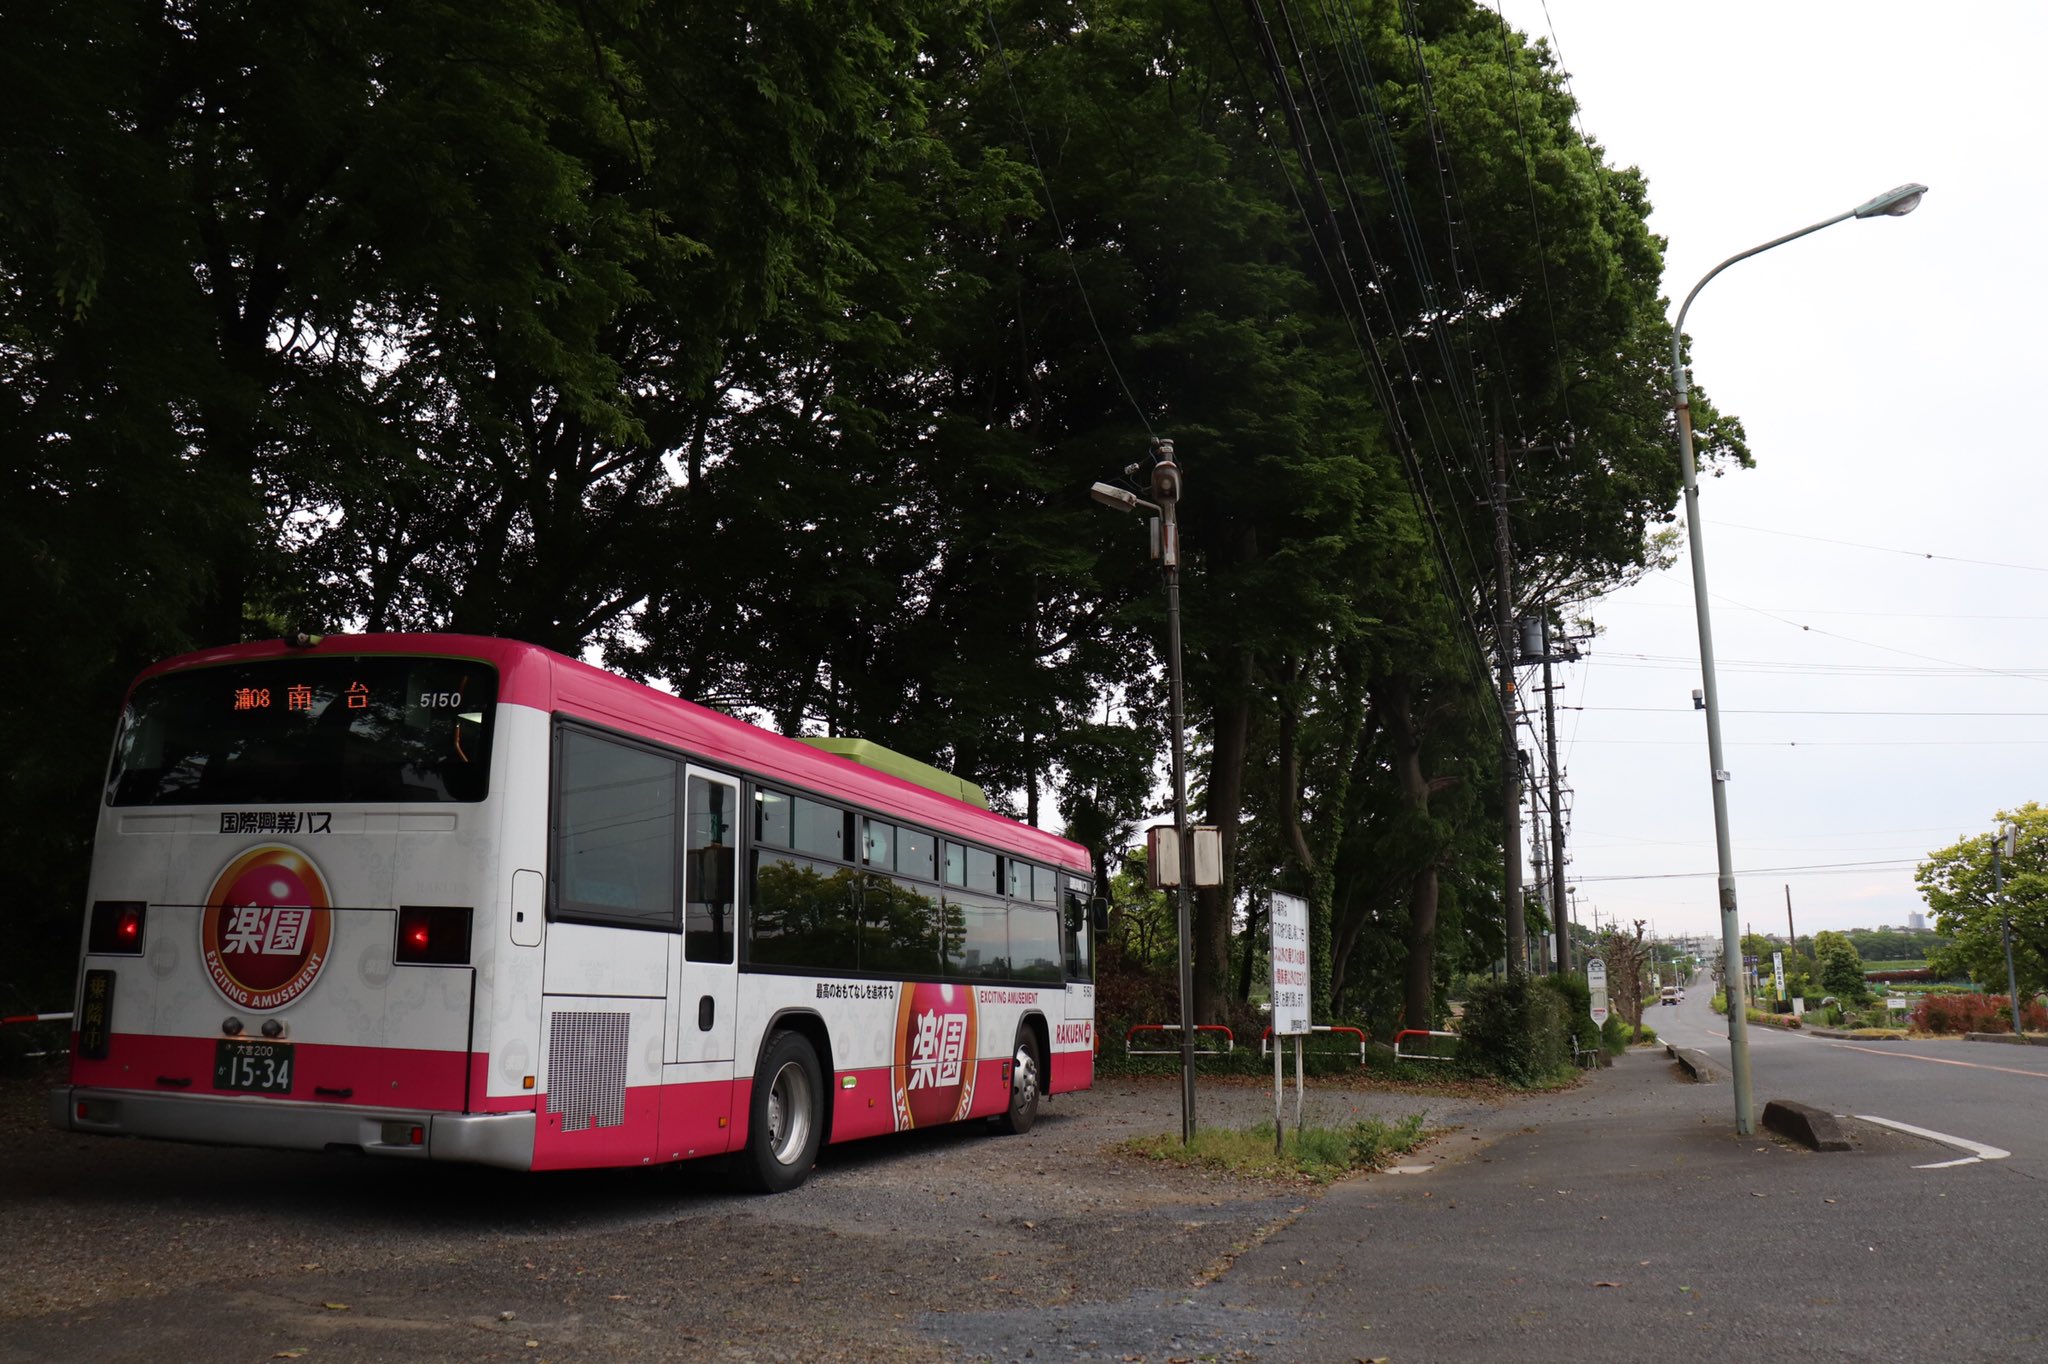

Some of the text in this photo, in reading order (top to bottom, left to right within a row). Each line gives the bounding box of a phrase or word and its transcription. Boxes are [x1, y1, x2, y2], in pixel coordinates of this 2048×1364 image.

[234, 687, 270, 711] 浦08
[419, 691, 462, 709] 5150
[219, 811, 333, 834] 国際興業バス
[221, 901, 314, 956] 楽園
[205, 950, 324, 1008] EXCITING AMUSEMENT
[815, 982, 895, 1000] 最高のおもてなしを追求する
[980, 990, 1039, 1005] EXCITING AMUSEMENT
[1056, 1023, 1084, 1045] RAKUEN
[236, 1044, 274, 1057] 大宮200
[907, 1007, 968, 1091] 楽園
[230, 1056, 289, 1089] 15-34
